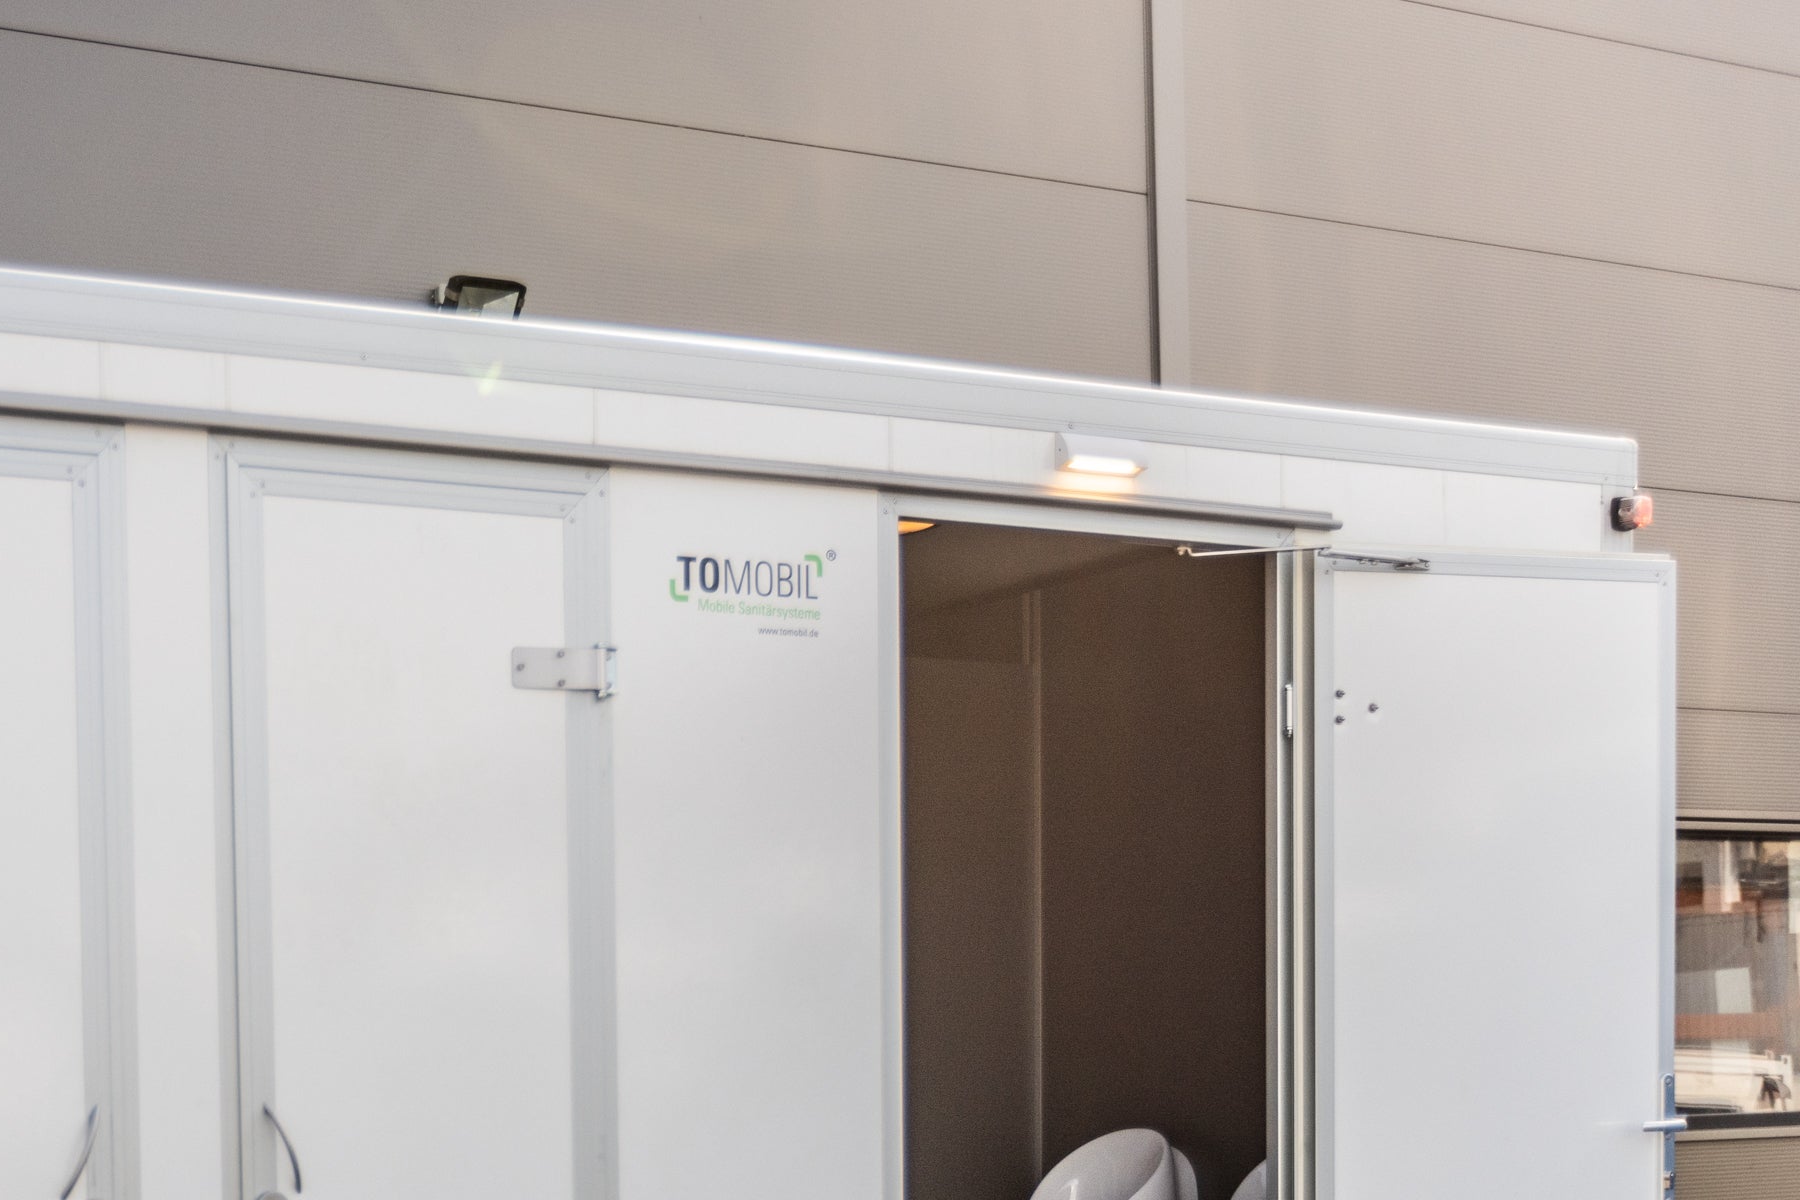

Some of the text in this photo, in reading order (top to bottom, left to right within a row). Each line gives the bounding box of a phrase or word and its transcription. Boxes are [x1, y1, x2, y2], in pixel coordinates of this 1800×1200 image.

[677, 556, 818, 600] TOMOBIL
[698, 599, 821, 621] Mobile Sanitärsysteme
[758, 626, 819, 638] www.tomobil.de
